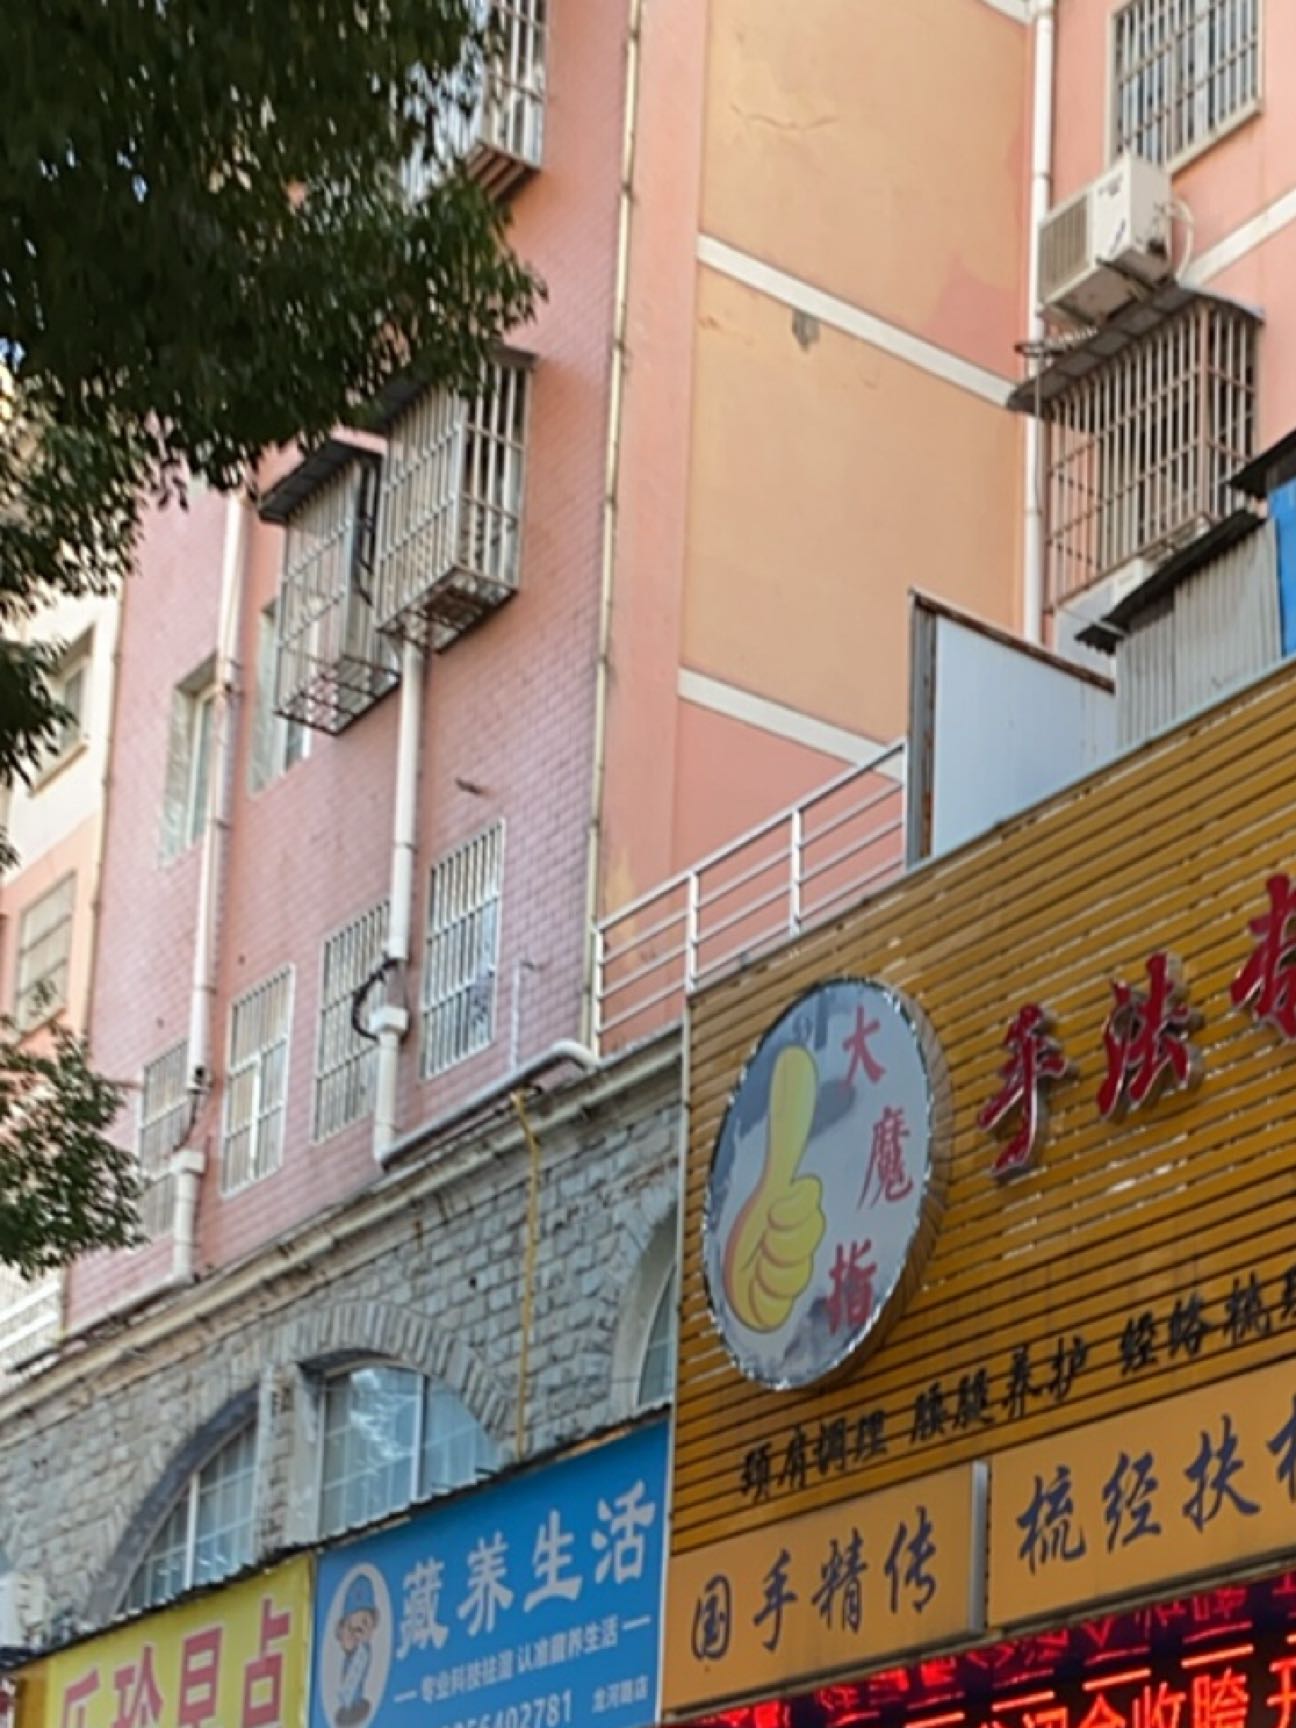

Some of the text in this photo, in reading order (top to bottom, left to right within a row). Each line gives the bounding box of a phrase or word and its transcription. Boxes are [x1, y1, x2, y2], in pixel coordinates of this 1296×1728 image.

[822, 1003, 915, 1336] 大魔指
[396, 1479, 656, 1660] 藏养生活
[691, 1506, 940, 1663] 国手精传
